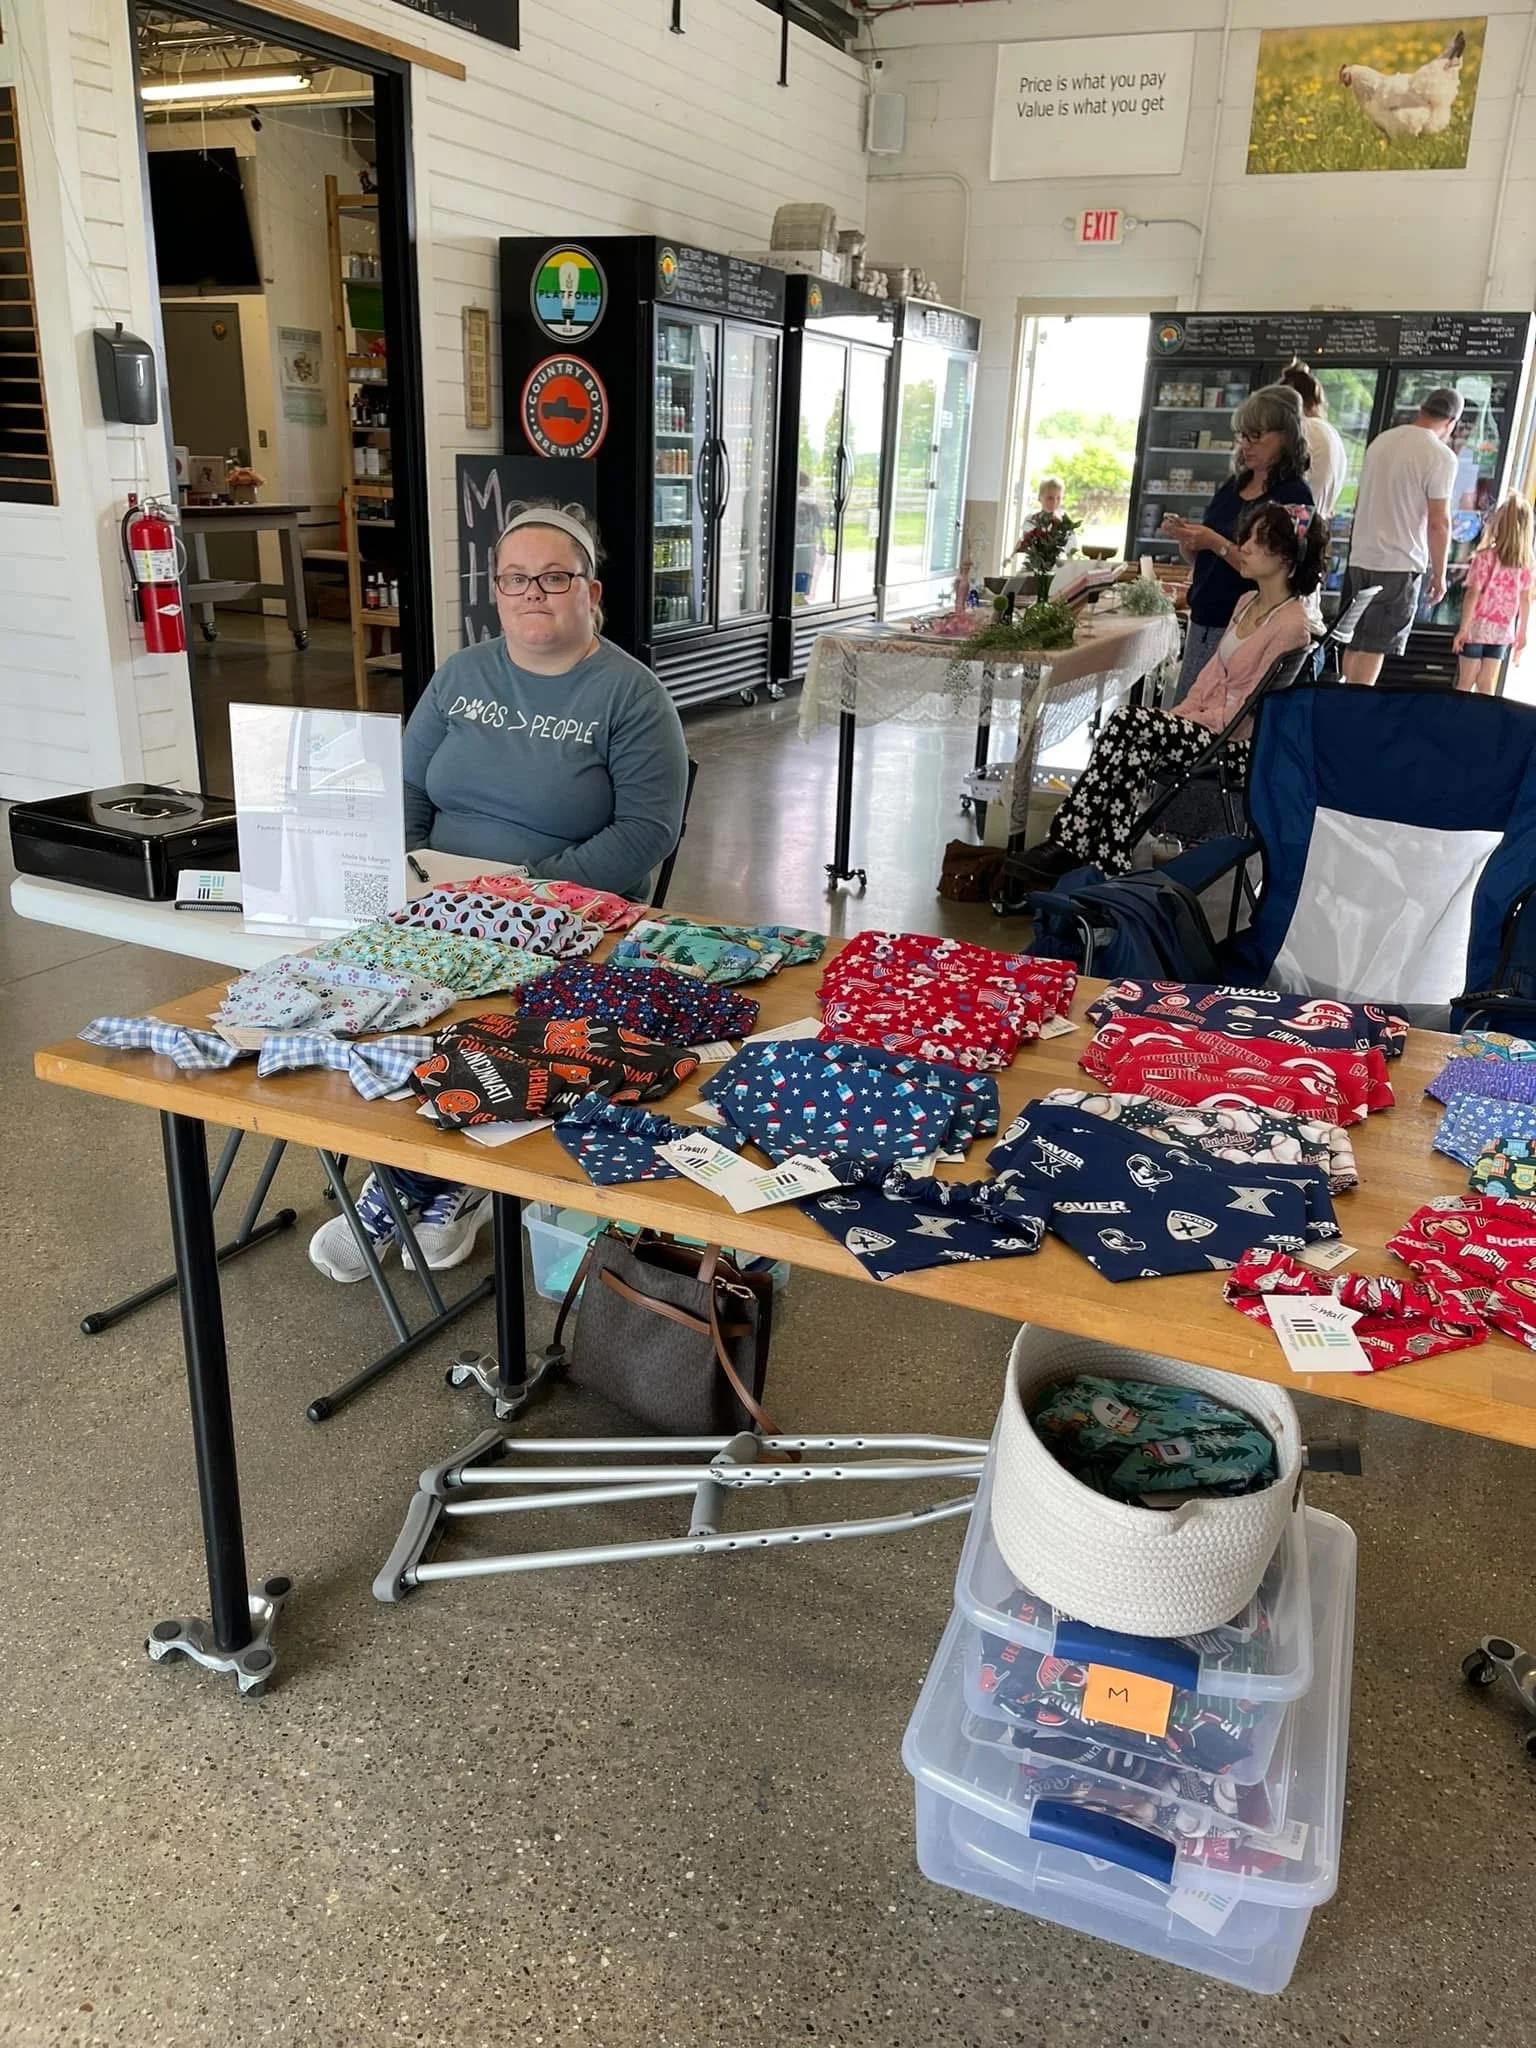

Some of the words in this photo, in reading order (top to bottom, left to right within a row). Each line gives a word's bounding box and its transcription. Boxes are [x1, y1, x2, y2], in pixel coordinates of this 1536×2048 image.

[1020, 77, 1052, 93] Price
[1056, 75, 1068, 91] is
[1072, 73, 1105, 90] what
[1110, 74, 1136, 92] you
[1140, 71, 1166, 90] pay
[1016, 101, 1054, 117] Value
[1058, 100, 1069, 116] is
[1073, 97, 1107, 115] what
[1111, 98, 1137, 116] you
[1141, 96, 1164, 115] get
[1083, 211, 1118, 240] EXIT
[538, 290, 599, 300] PLATFORM
[528, 362, 583, 405] COUNTRY
[584, 376, 602, 413] BOY
[534, 430, 594, 457] BREWING
[529, 713, 600, 745] PEOPLE
[1308, 1016, 1350, 1030] REDS
[1031, 1135, 1086, 1170] XAVIER
[1173, 1211, 1215, 1229] XAVIER
[1308, 1302, 1350, 1321] Small
[1107, 1686, 1130, 1703] M
